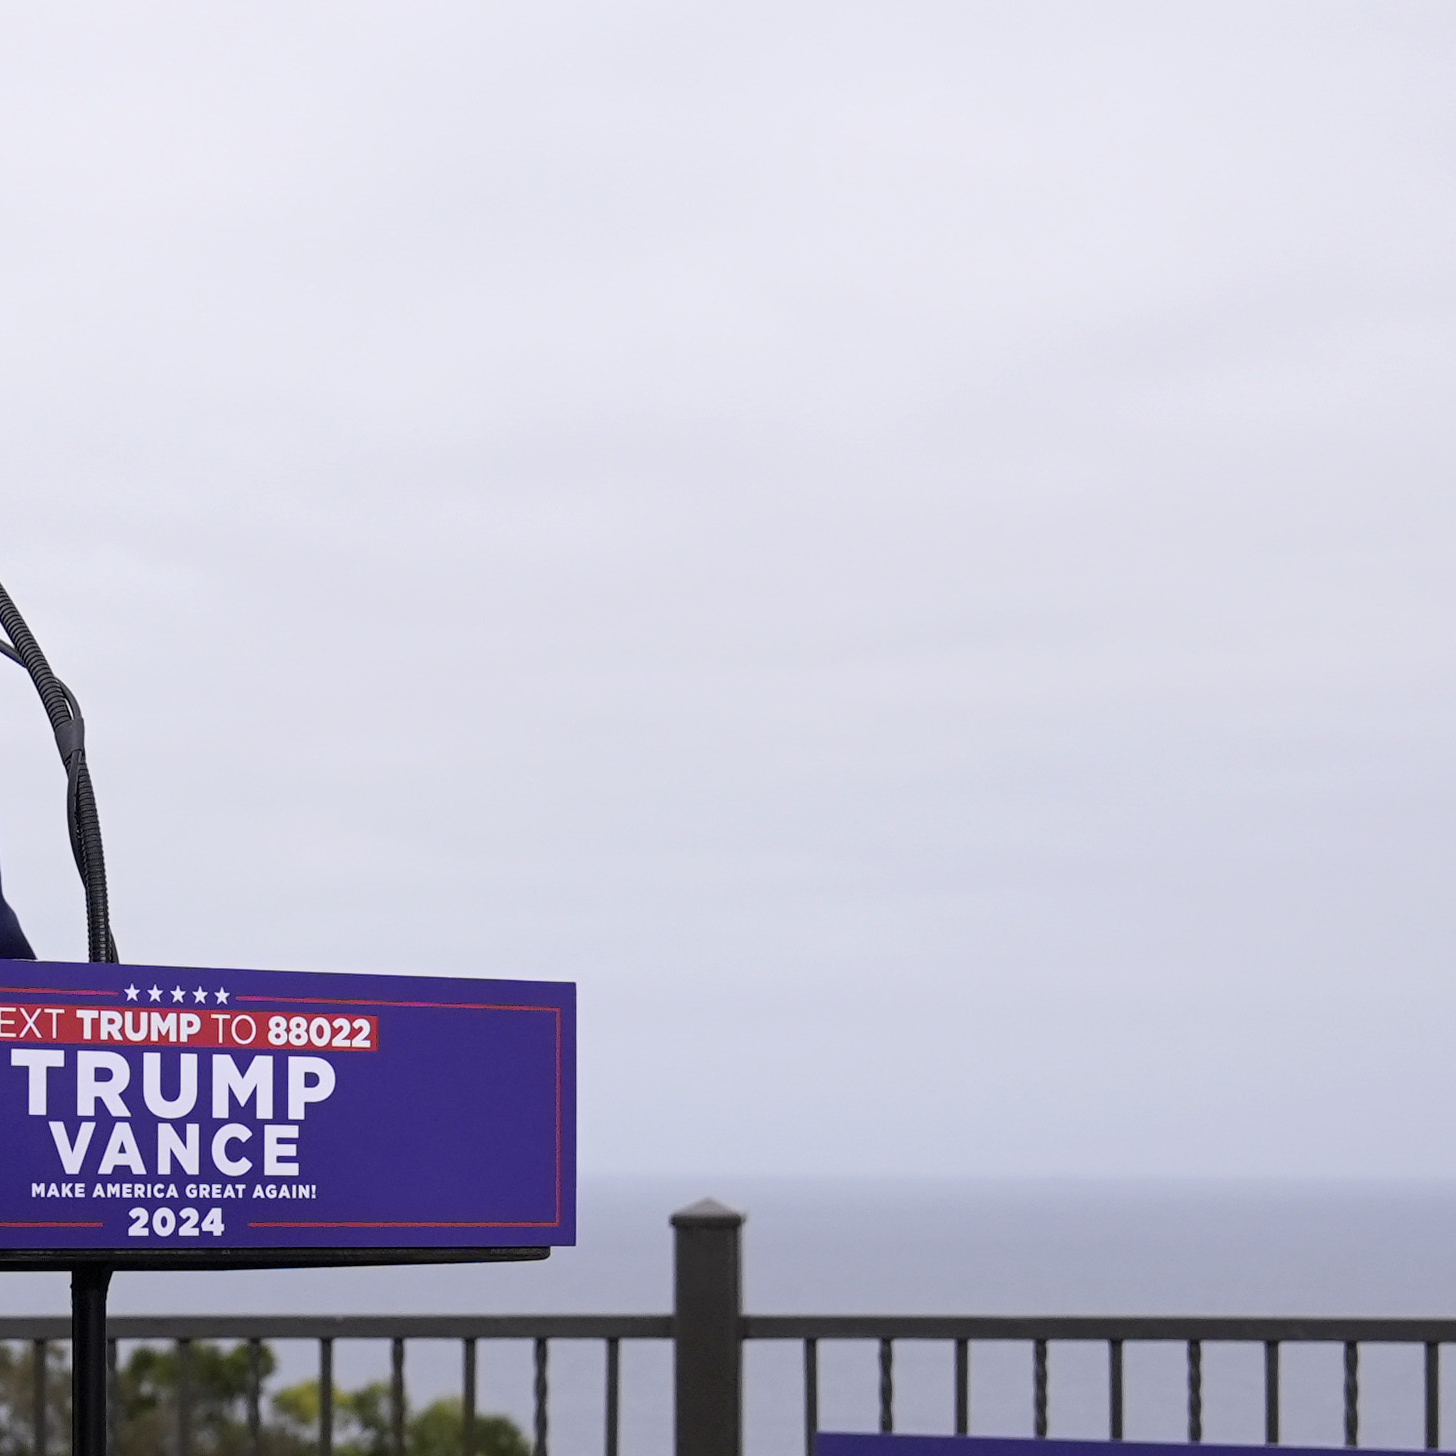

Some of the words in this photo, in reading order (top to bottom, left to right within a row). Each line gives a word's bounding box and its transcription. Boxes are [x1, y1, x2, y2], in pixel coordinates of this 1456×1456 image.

[75, 1009, 202, 1043] TRUMP
[210, 1013, 257, 1045] TO
[267, 1016, 372, 1048] 88022
[10, 1048, 336, 1121] TRUMP
[48, 1120, 300, 1177] VANCE
[31, 1182, 86, 1198] MAKE
[92, 1182, 179, 1199] AMERICA
[185, 1183, 247, 1199] GREAT
[252, 1183, 317, 1200] AGAIN!
[127, 1206, 225, 1237] 2024
